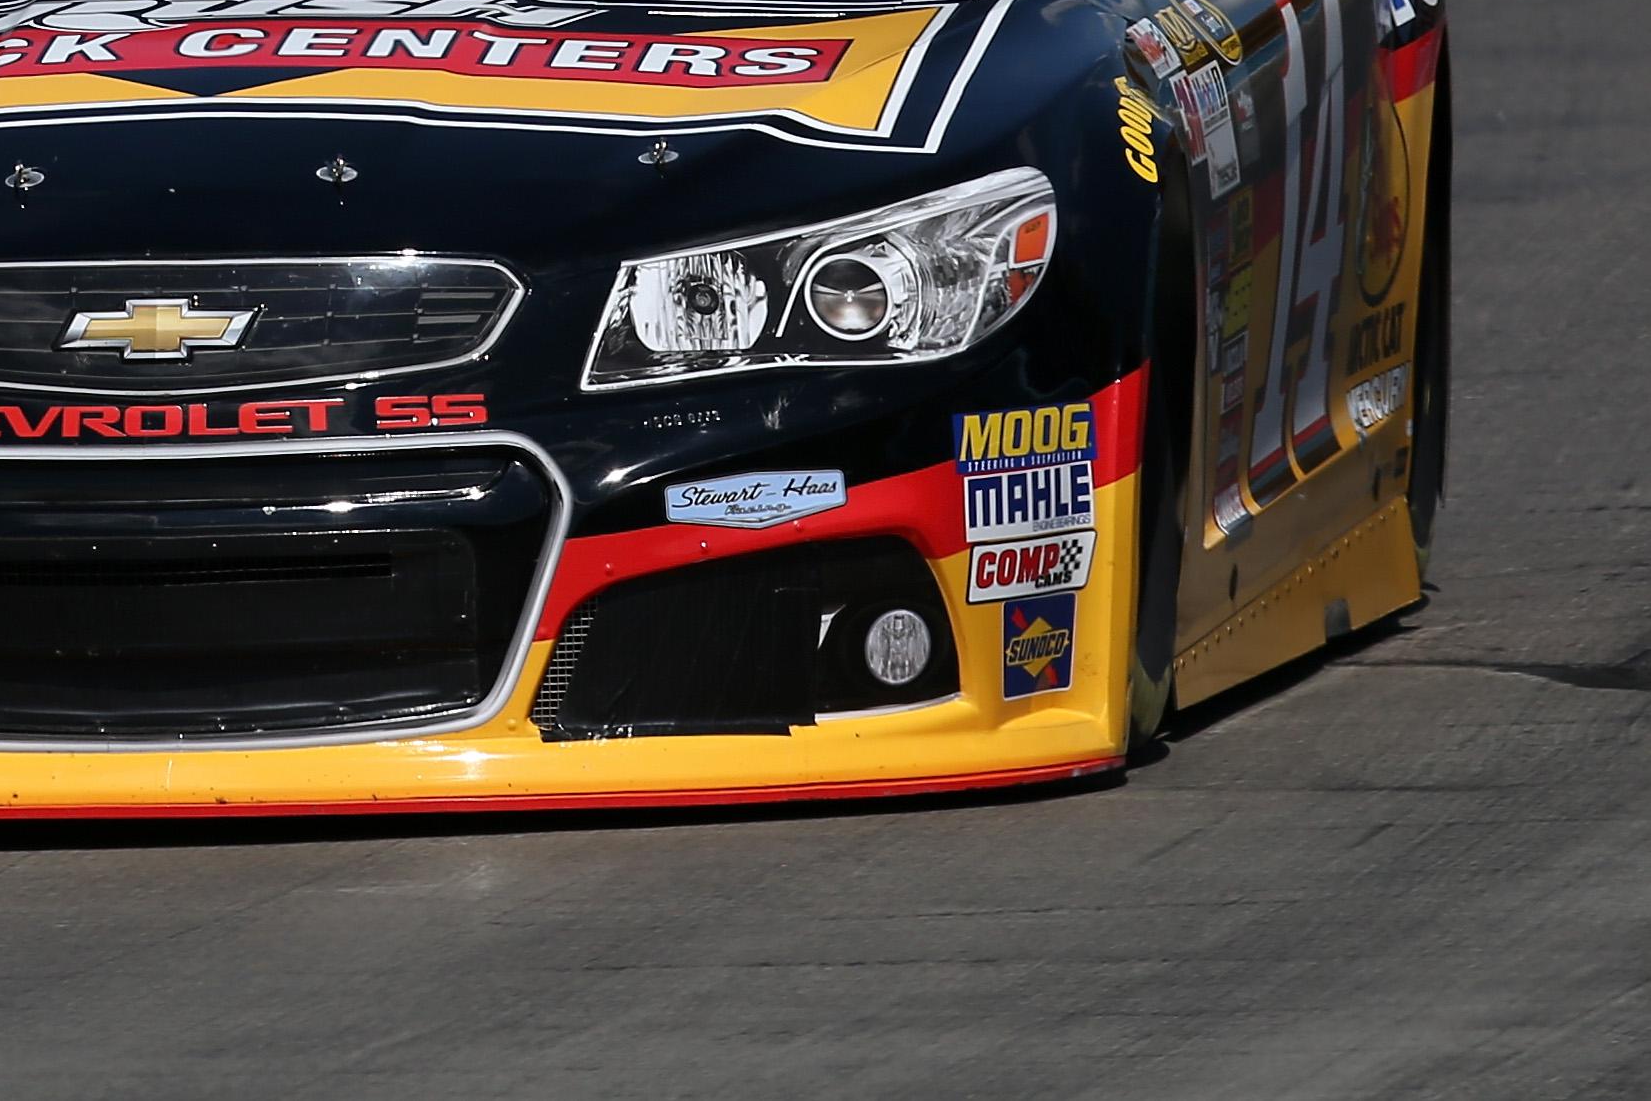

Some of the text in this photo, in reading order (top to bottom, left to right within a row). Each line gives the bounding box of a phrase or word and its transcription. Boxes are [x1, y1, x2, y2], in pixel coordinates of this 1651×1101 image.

[177, 27, 822, 81] CENTERS
[376, 393, 488, 429] SS
[959, 403, 1090, 462] MOOG
[782, 476, 837, 497] Haas
[968, 463, 1091, 528] MAHLE
[975, 542, 1061, 589] COMP
[1034, 569, 1073, 589] CAMS
[1008, 631, 1069, 663] SUNOCO
